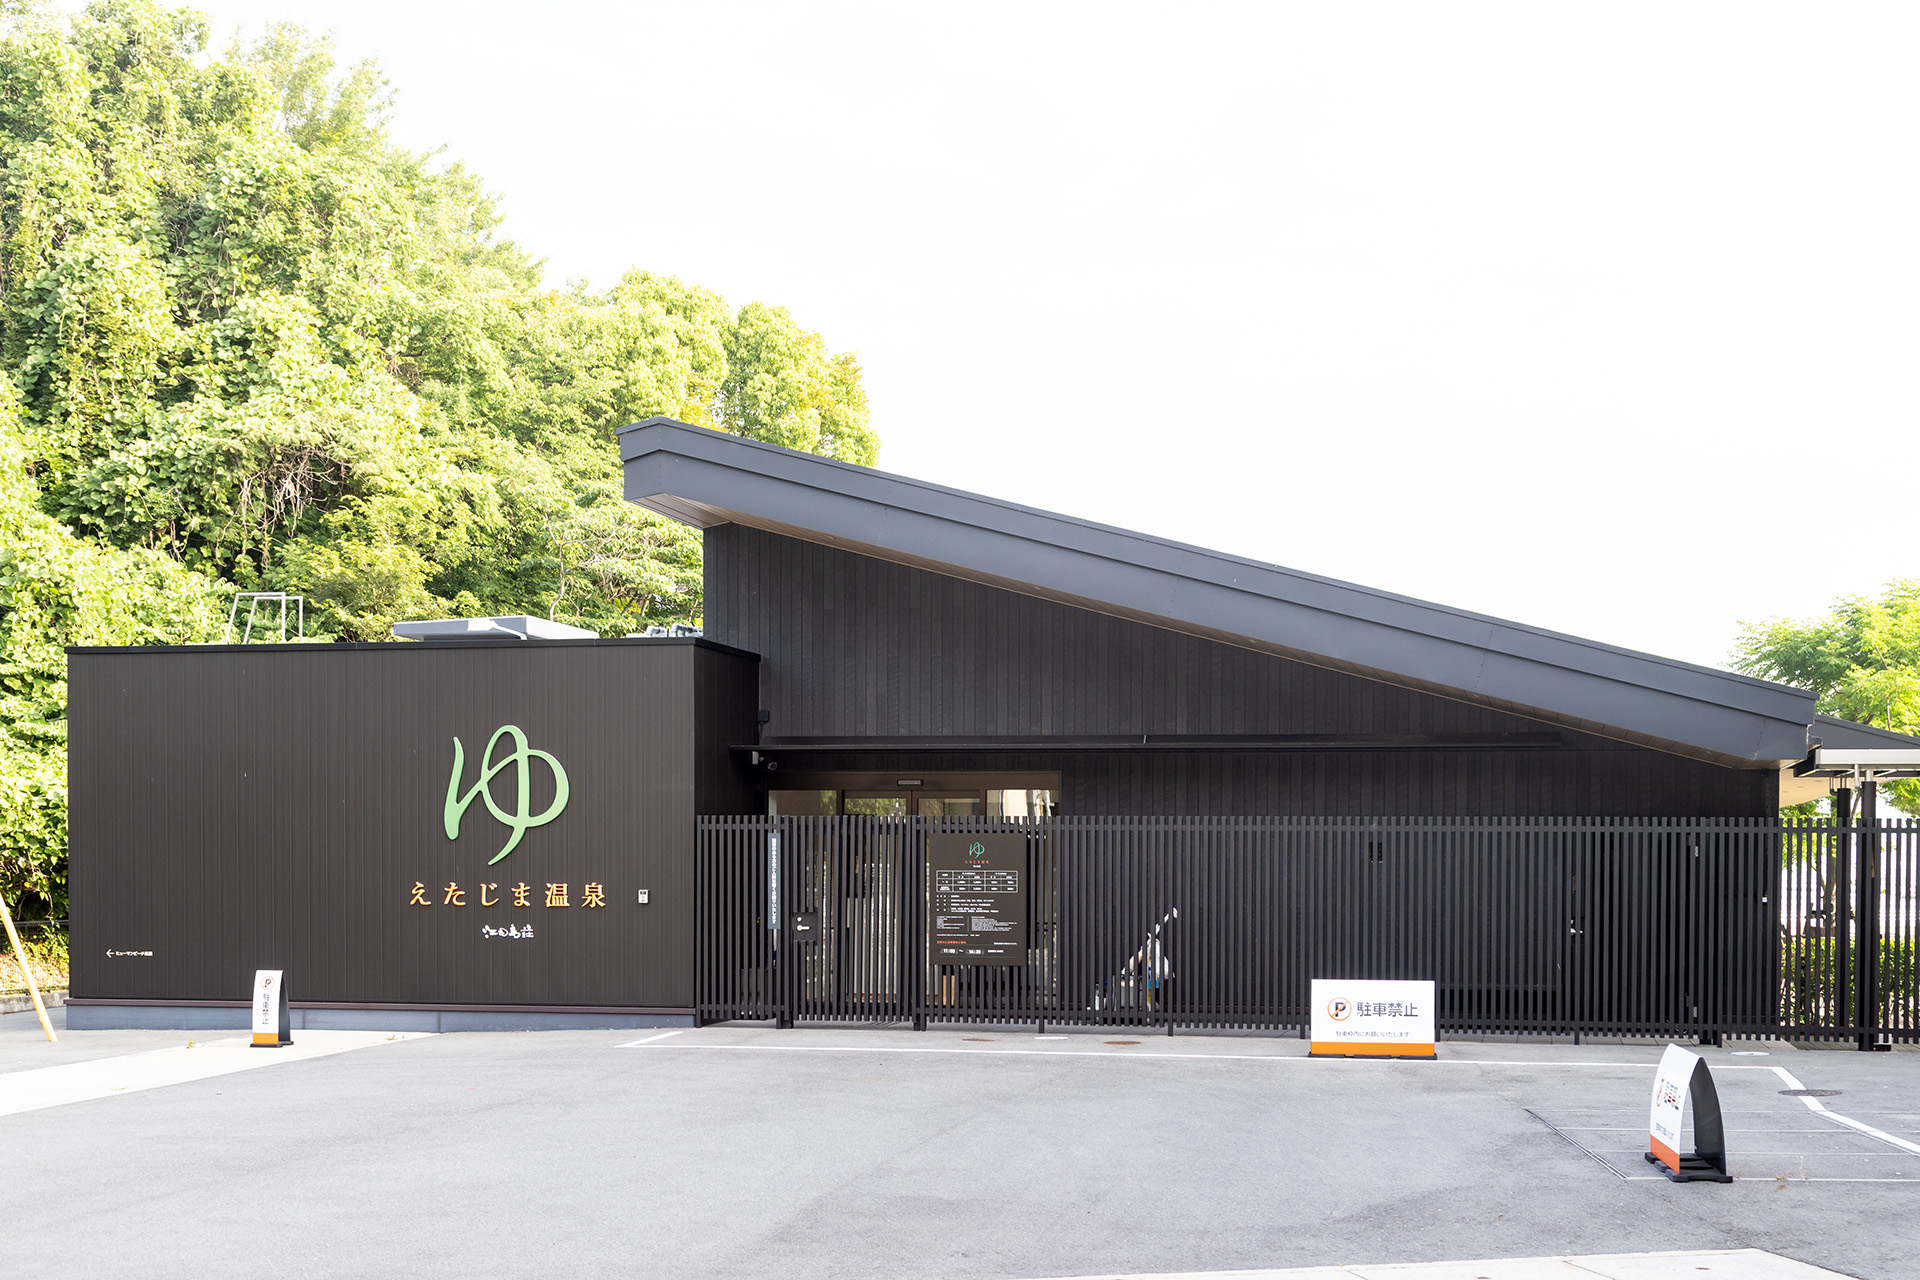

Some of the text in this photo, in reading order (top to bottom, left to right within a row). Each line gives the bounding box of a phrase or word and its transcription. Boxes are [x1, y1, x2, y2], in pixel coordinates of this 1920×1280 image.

[444, 725, 570, 866] ゆ
[969, 841, 985, 859] ゆ
[409, 881, 607, 908] えたじま温泉
[1356, 1002, 1419, 1018] 駐車禁止
